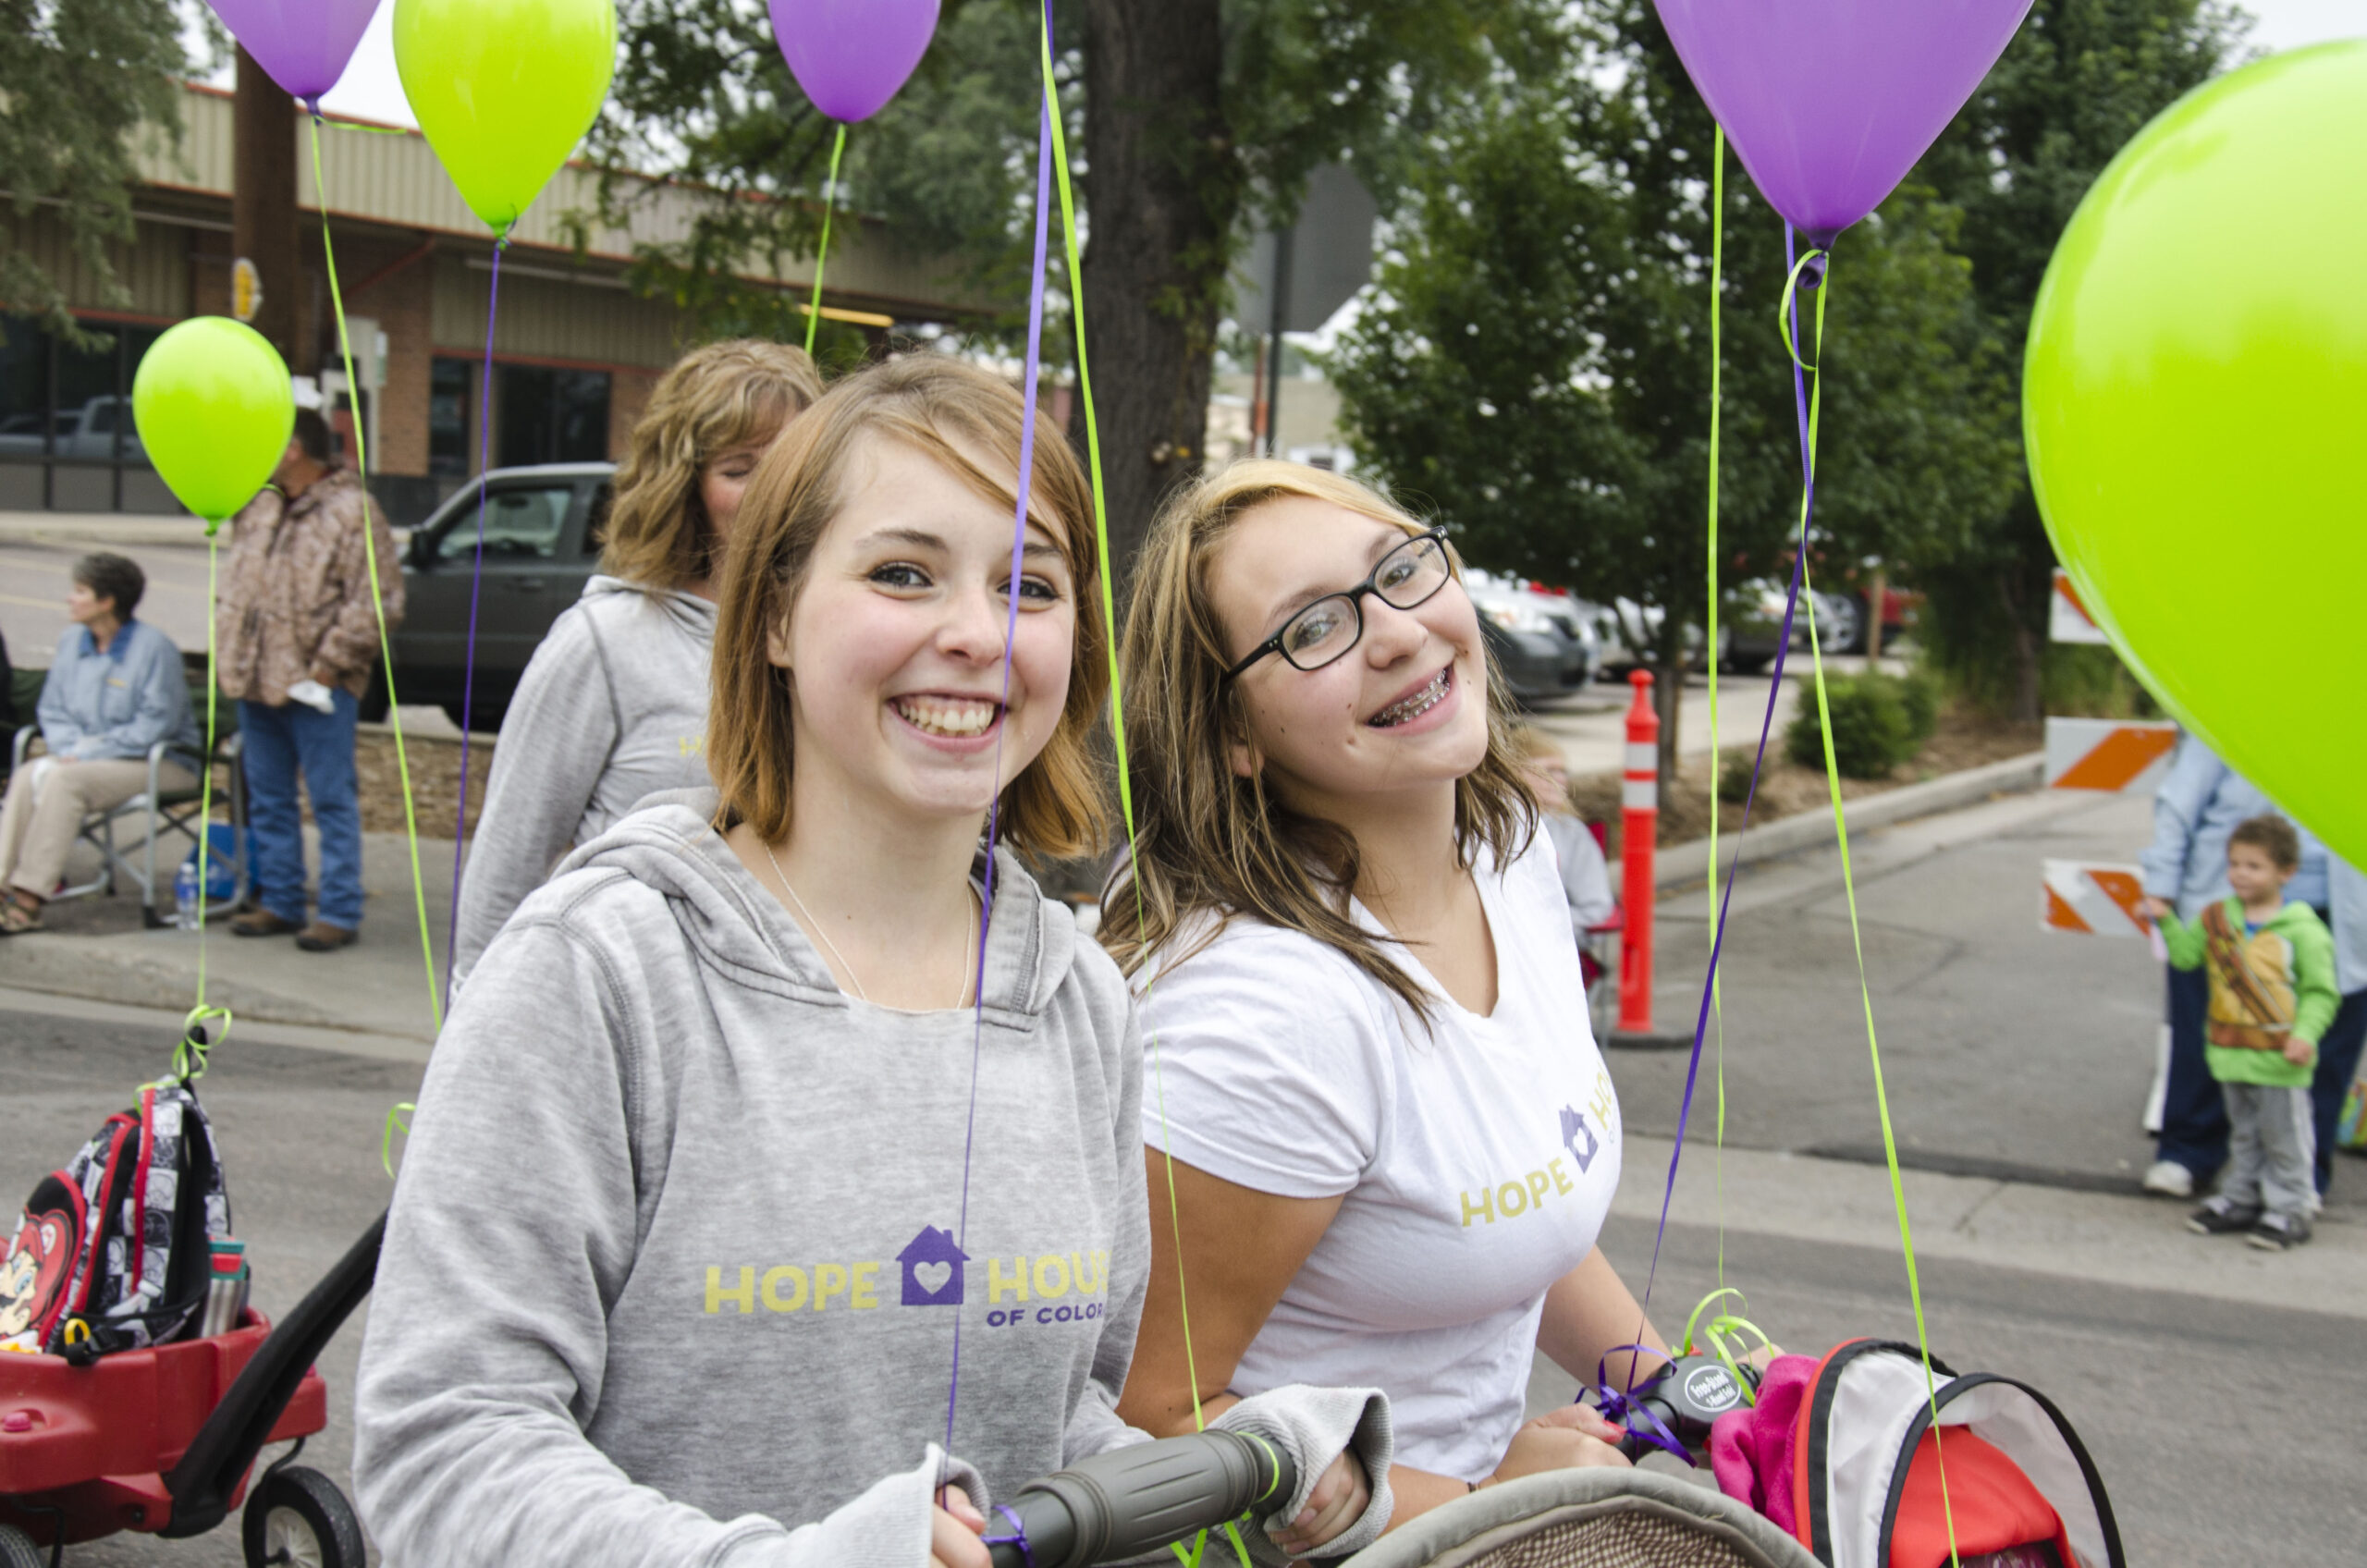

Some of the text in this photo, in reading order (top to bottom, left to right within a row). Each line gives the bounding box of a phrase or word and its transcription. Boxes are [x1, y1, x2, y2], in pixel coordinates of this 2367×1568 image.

[1460, 1157, 1574, 1228] HOPE
[705, 1250, 1112, 1315] HOPE HOUS
[987, 1302, 1106, 1328] OF COLOR
